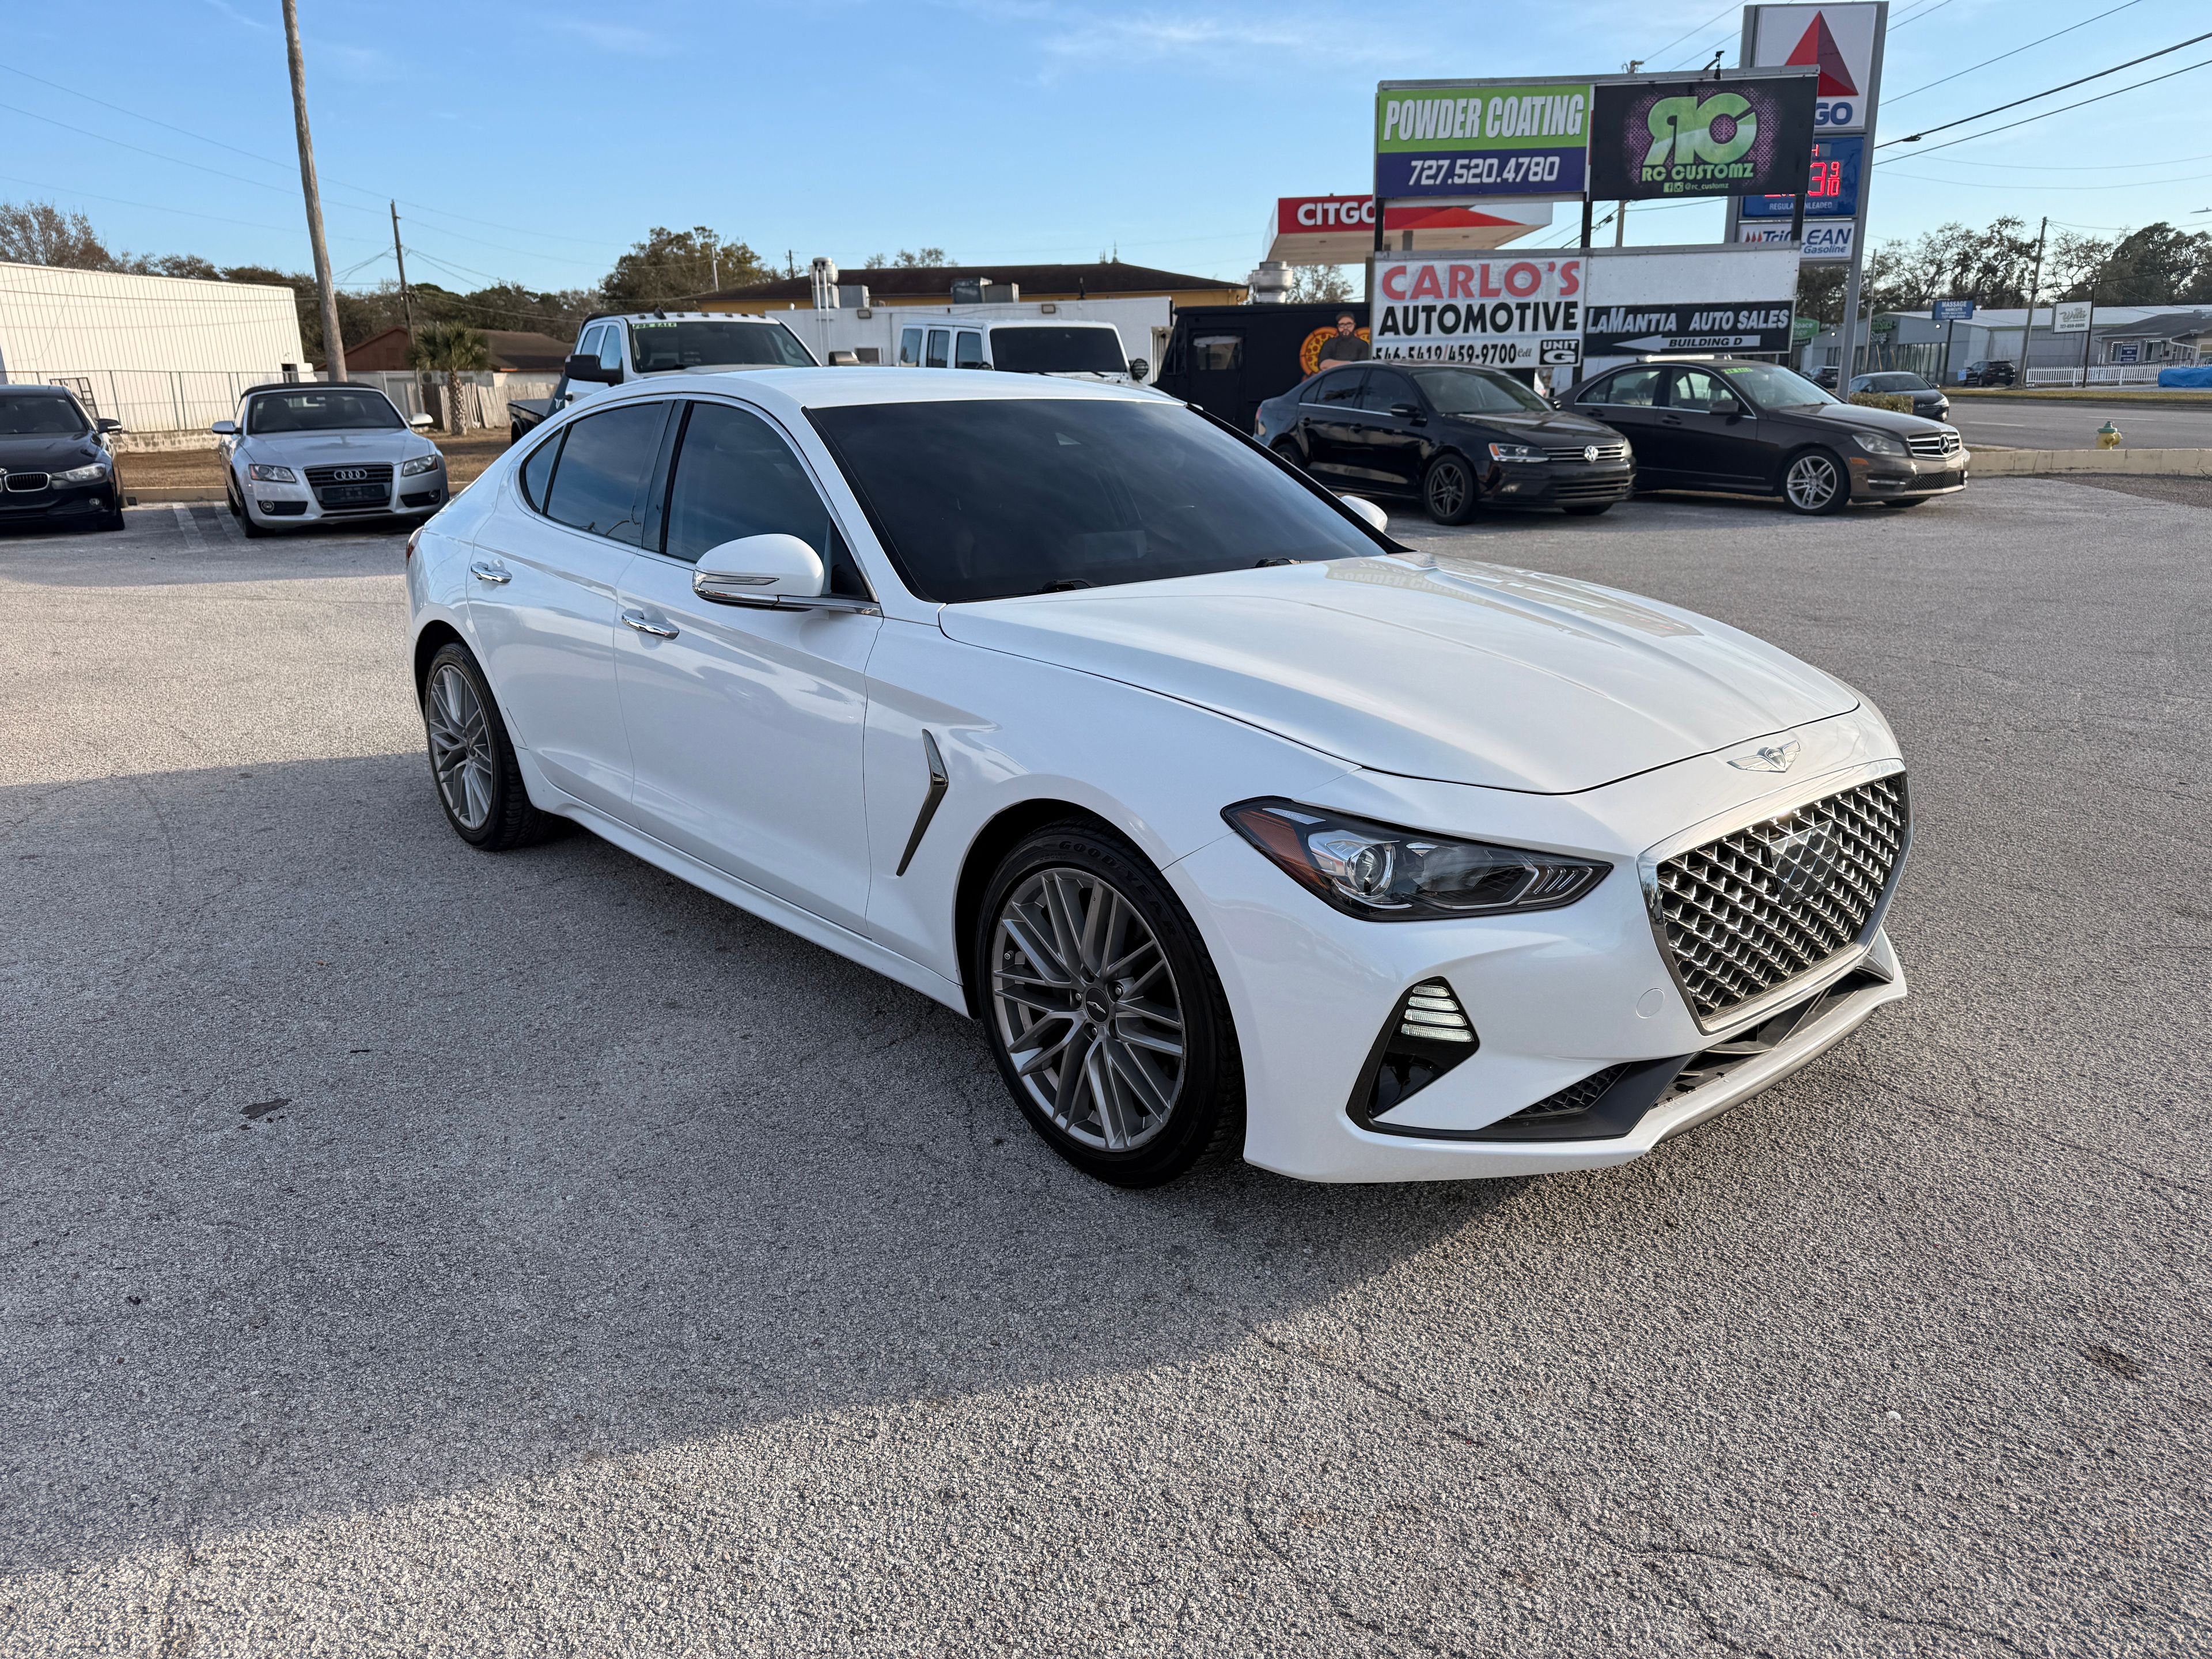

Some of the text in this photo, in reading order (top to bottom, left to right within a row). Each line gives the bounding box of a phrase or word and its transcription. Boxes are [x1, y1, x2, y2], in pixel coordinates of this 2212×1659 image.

[1383, 94, 1584, 141] POWDER COATING
[1408, 156, 1560, 185] 727.520.4780
[1642, 163, 1754, 181] RC CUSTOMZ
[1297, 201, 1376, 226] CITGO
[1769, 202, 1832, 211] REGULA NLEADED
[1804, 245, 1847, 254] Gasoline
[1382, 261, 1580, 301] CARLO'S
[1378, 301, 1578, 336] AUTOMOTIVE
[1688, 311, 1734, 331] AUTO
[1737, 309, 1790, 330] SALES
[1543, 340, 1578, 350] UNIT
[1669, 338, 1730, 347] BUILDING
[1543, 350, 1576, 363] G
